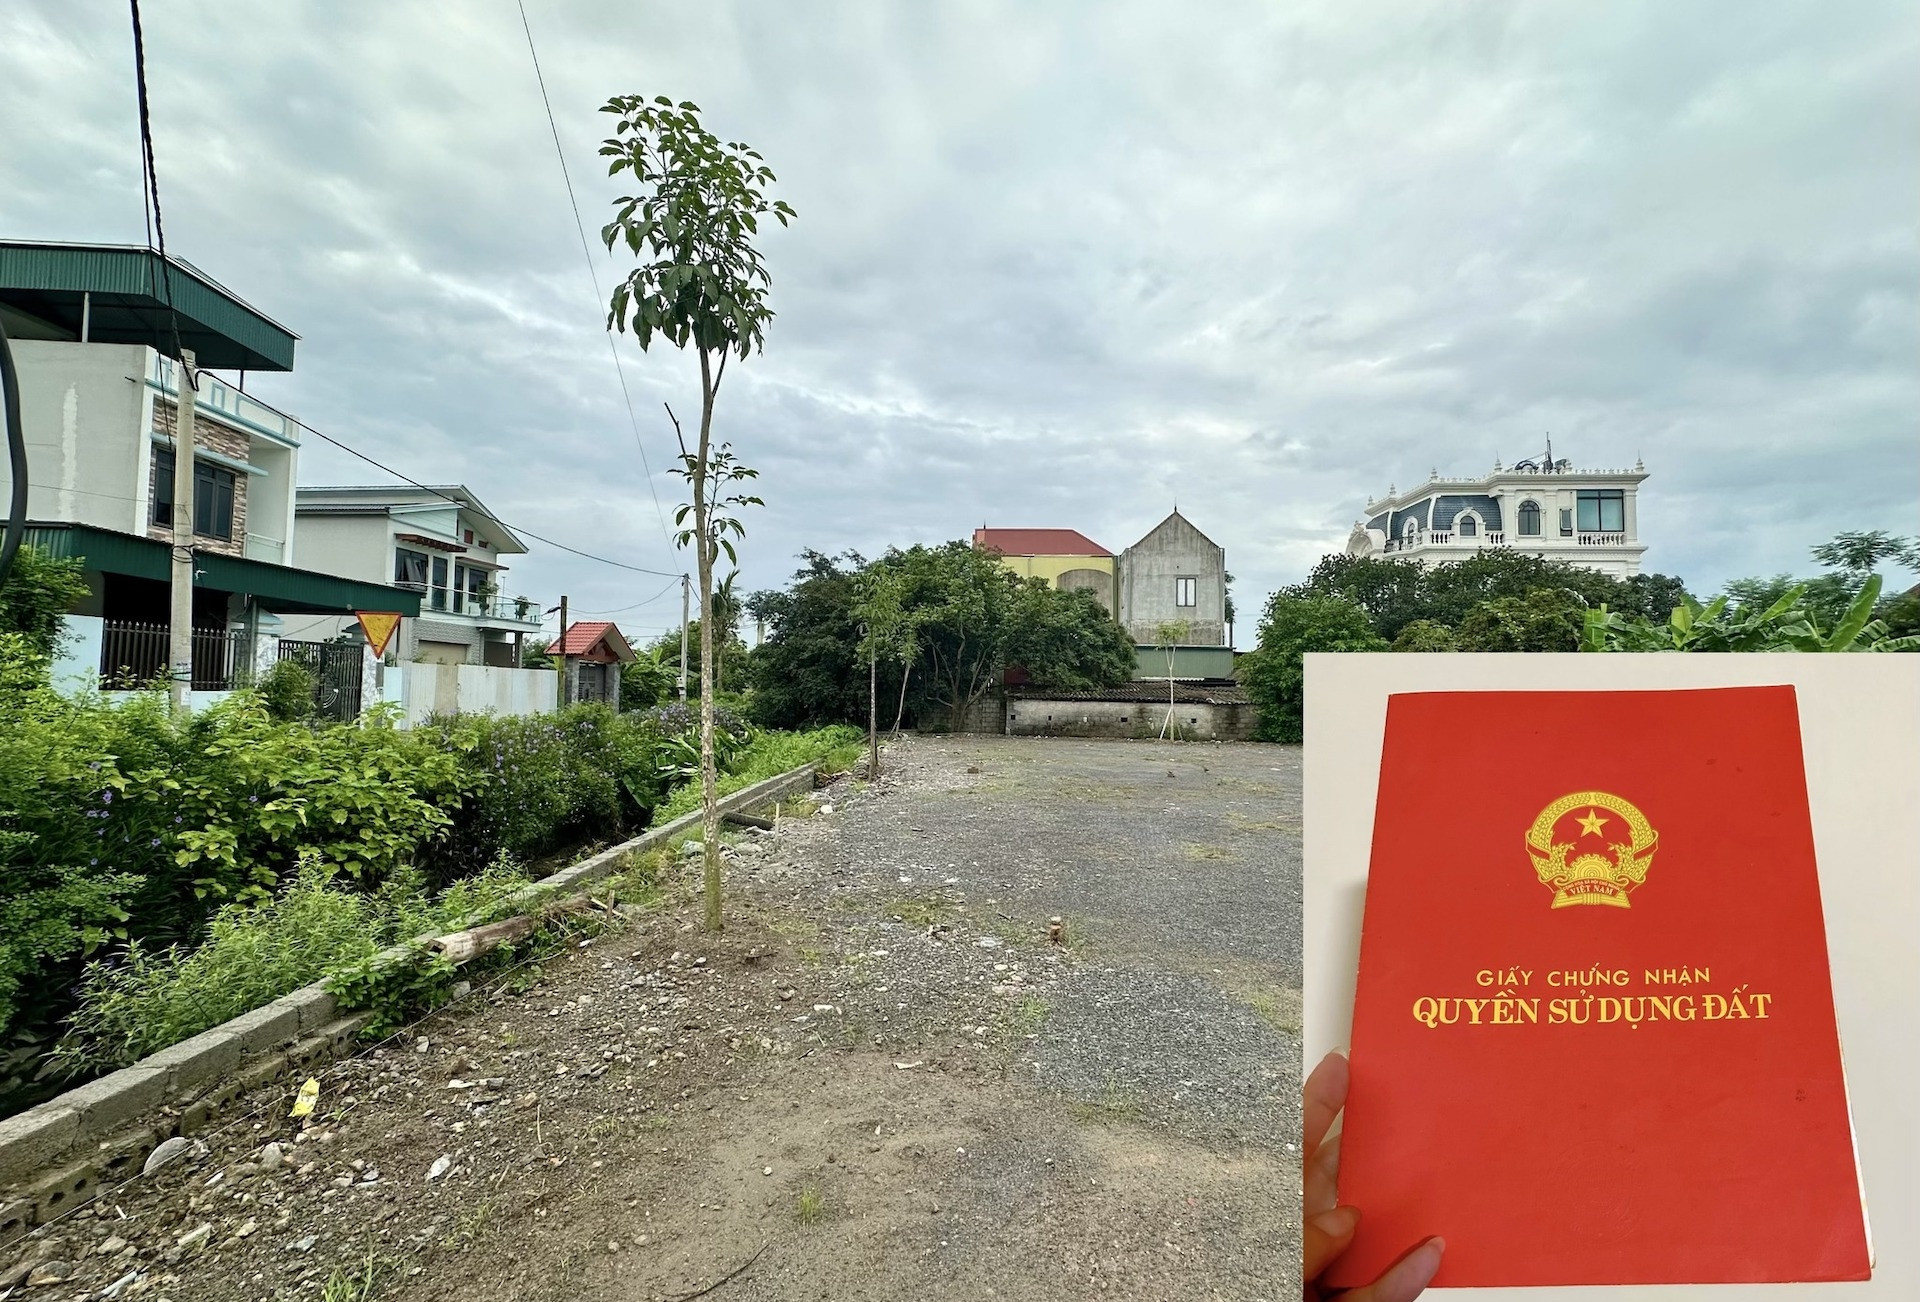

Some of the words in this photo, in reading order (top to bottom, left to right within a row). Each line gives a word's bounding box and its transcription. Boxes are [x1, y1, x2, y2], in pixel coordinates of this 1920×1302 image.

[1570, 884, 1591, 895] VIỆT
[1593, 884, 1614, 896] NAM
[1475, 964, 1534, 987] GIẤY
[1546, 962, 1630, 987] CHỨNG
[1644, 964, 1711, 986] NHẬN
[1412, 987, 1541, 1029] QUYỀN
[1548, 987, 1596, 1025] SỬ
[1597, 995, 1698, 1030] DỤNG
[1701, 983, 1772, 1020] ĐẤT
